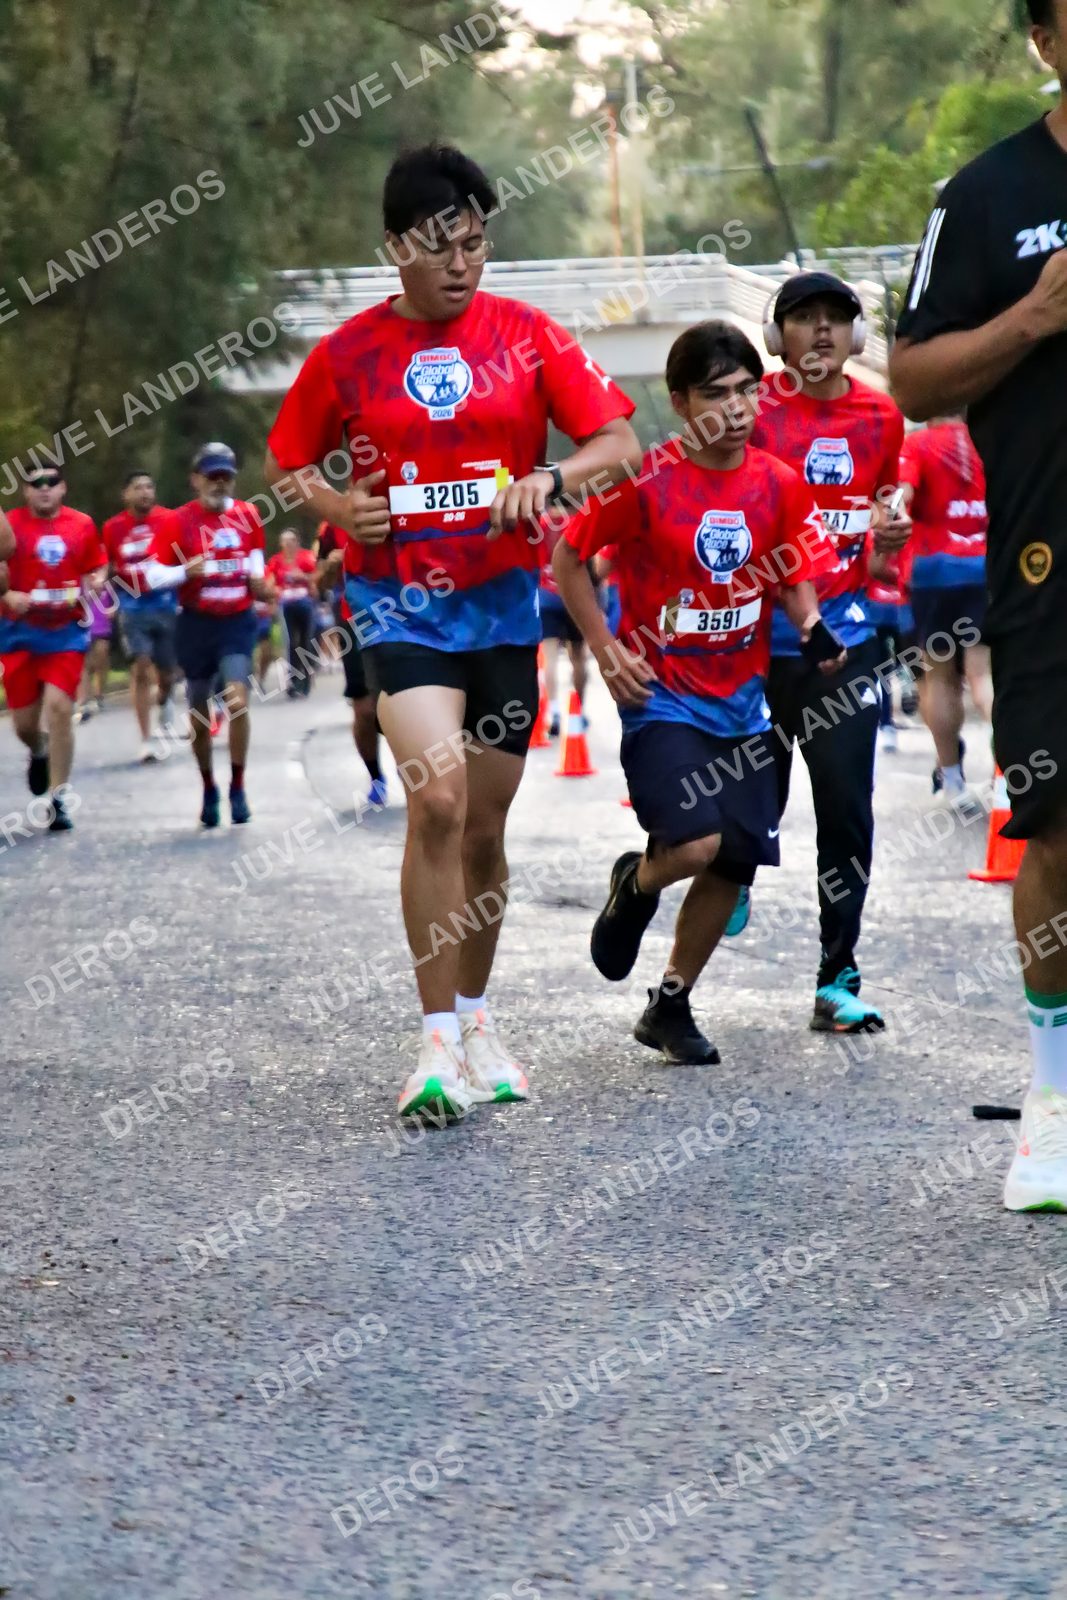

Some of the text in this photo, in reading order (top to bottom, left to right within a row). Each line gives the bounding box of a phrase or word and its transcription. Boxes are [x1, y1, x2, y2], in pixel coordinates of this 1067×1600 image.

[421, 364, 455, 376] Global
[415, 375, 443, 386] Race
[432, 408, 453, 418] 2026
[423, 482, 479, 510] 3205
[710, 529, 740, 540] Global
[704, 539, 729, 549] Race
[697, 609, 741, 631] 3591
